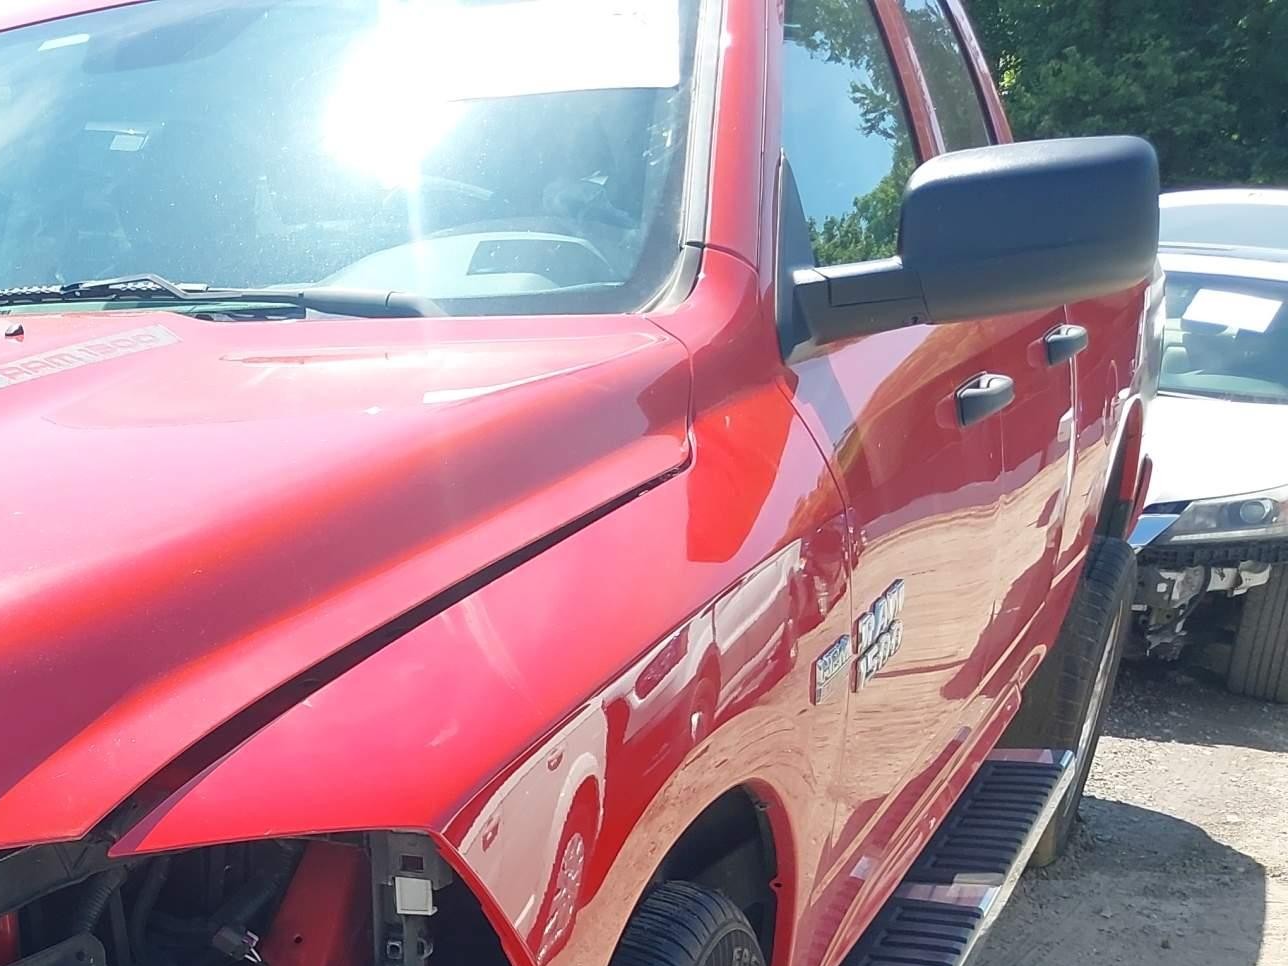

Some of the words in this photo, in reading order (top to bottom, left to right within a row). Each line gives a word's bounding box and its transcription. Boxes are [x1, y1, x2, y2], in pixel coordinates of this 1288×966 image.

[78, 334, 156, 357] 1500
[855, 579, 904, 653] RAM
[855, 619, 904, 689] 1500
